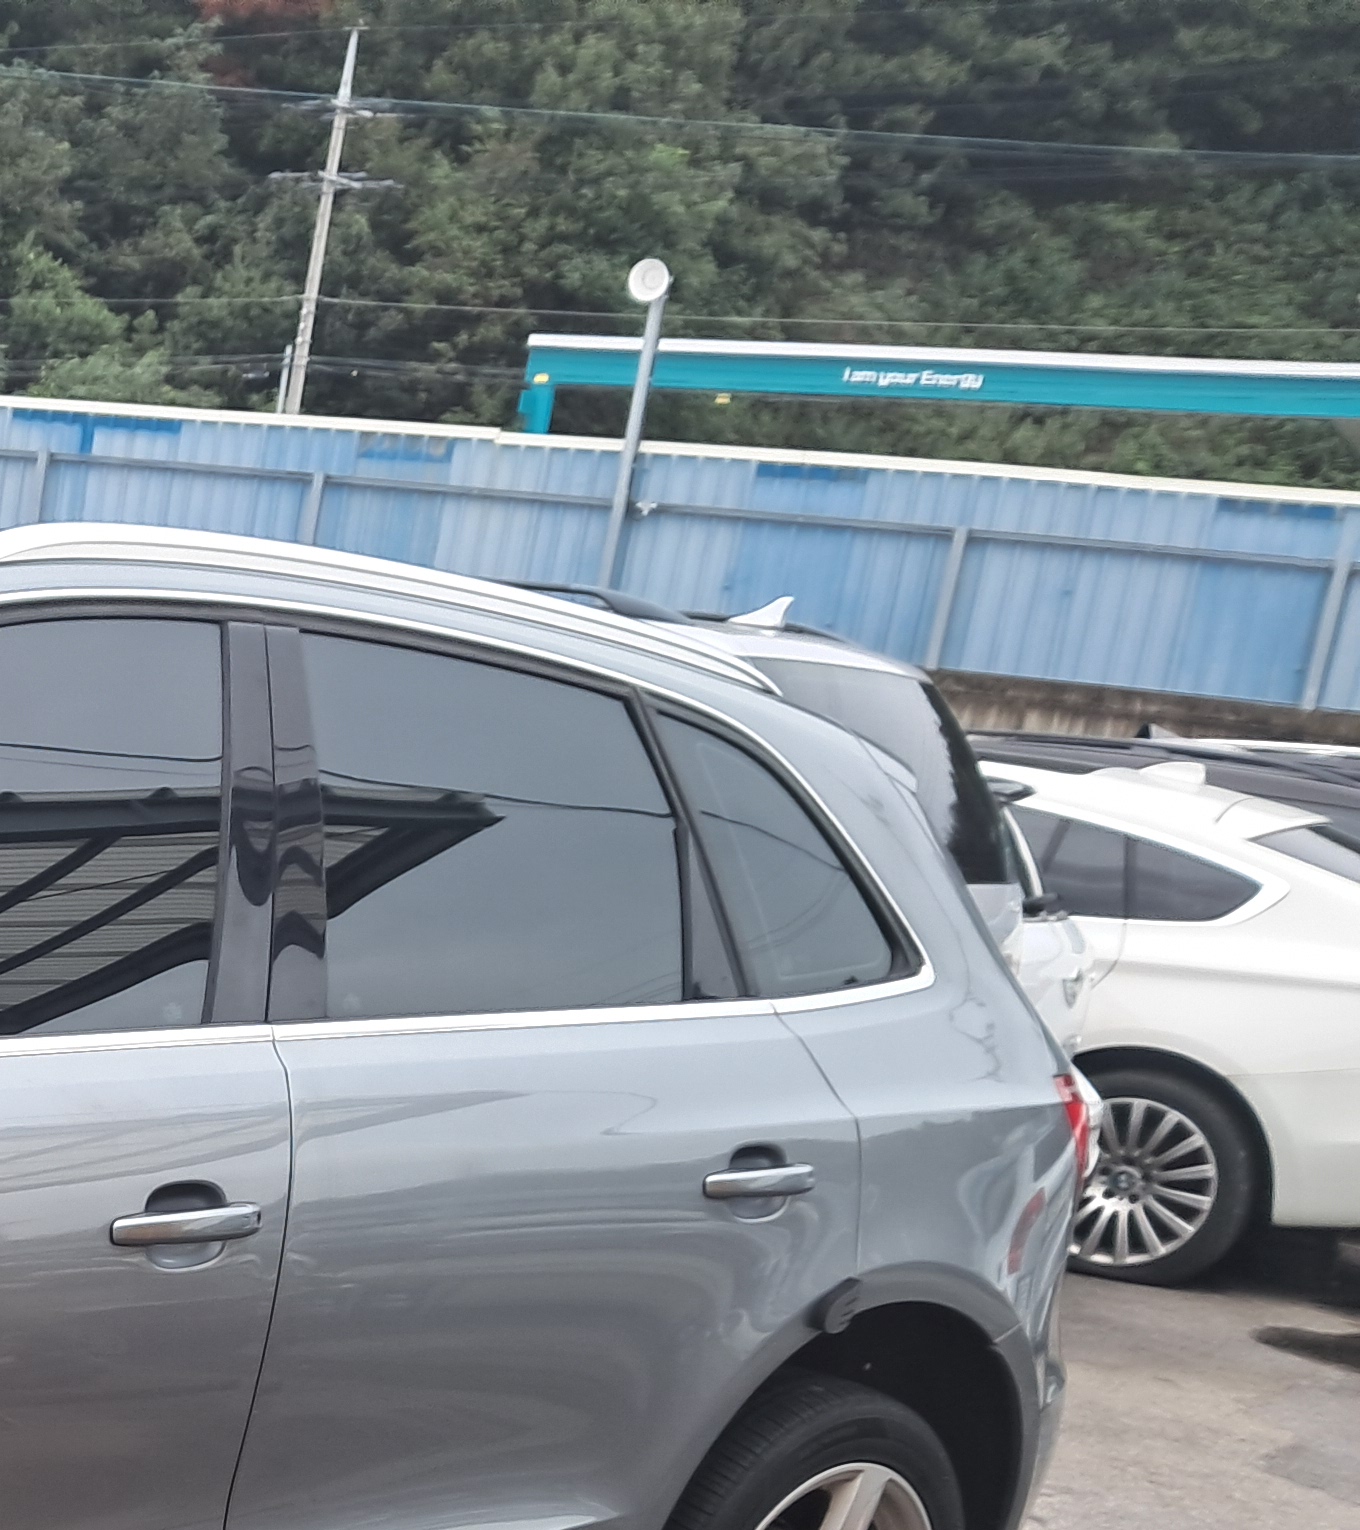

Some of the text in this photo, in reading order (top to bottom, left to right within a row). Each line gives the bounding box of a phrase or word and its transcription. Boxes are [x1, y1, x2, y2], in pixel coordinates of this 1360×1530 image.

[842, 366, 984, 391] I am your Energy
